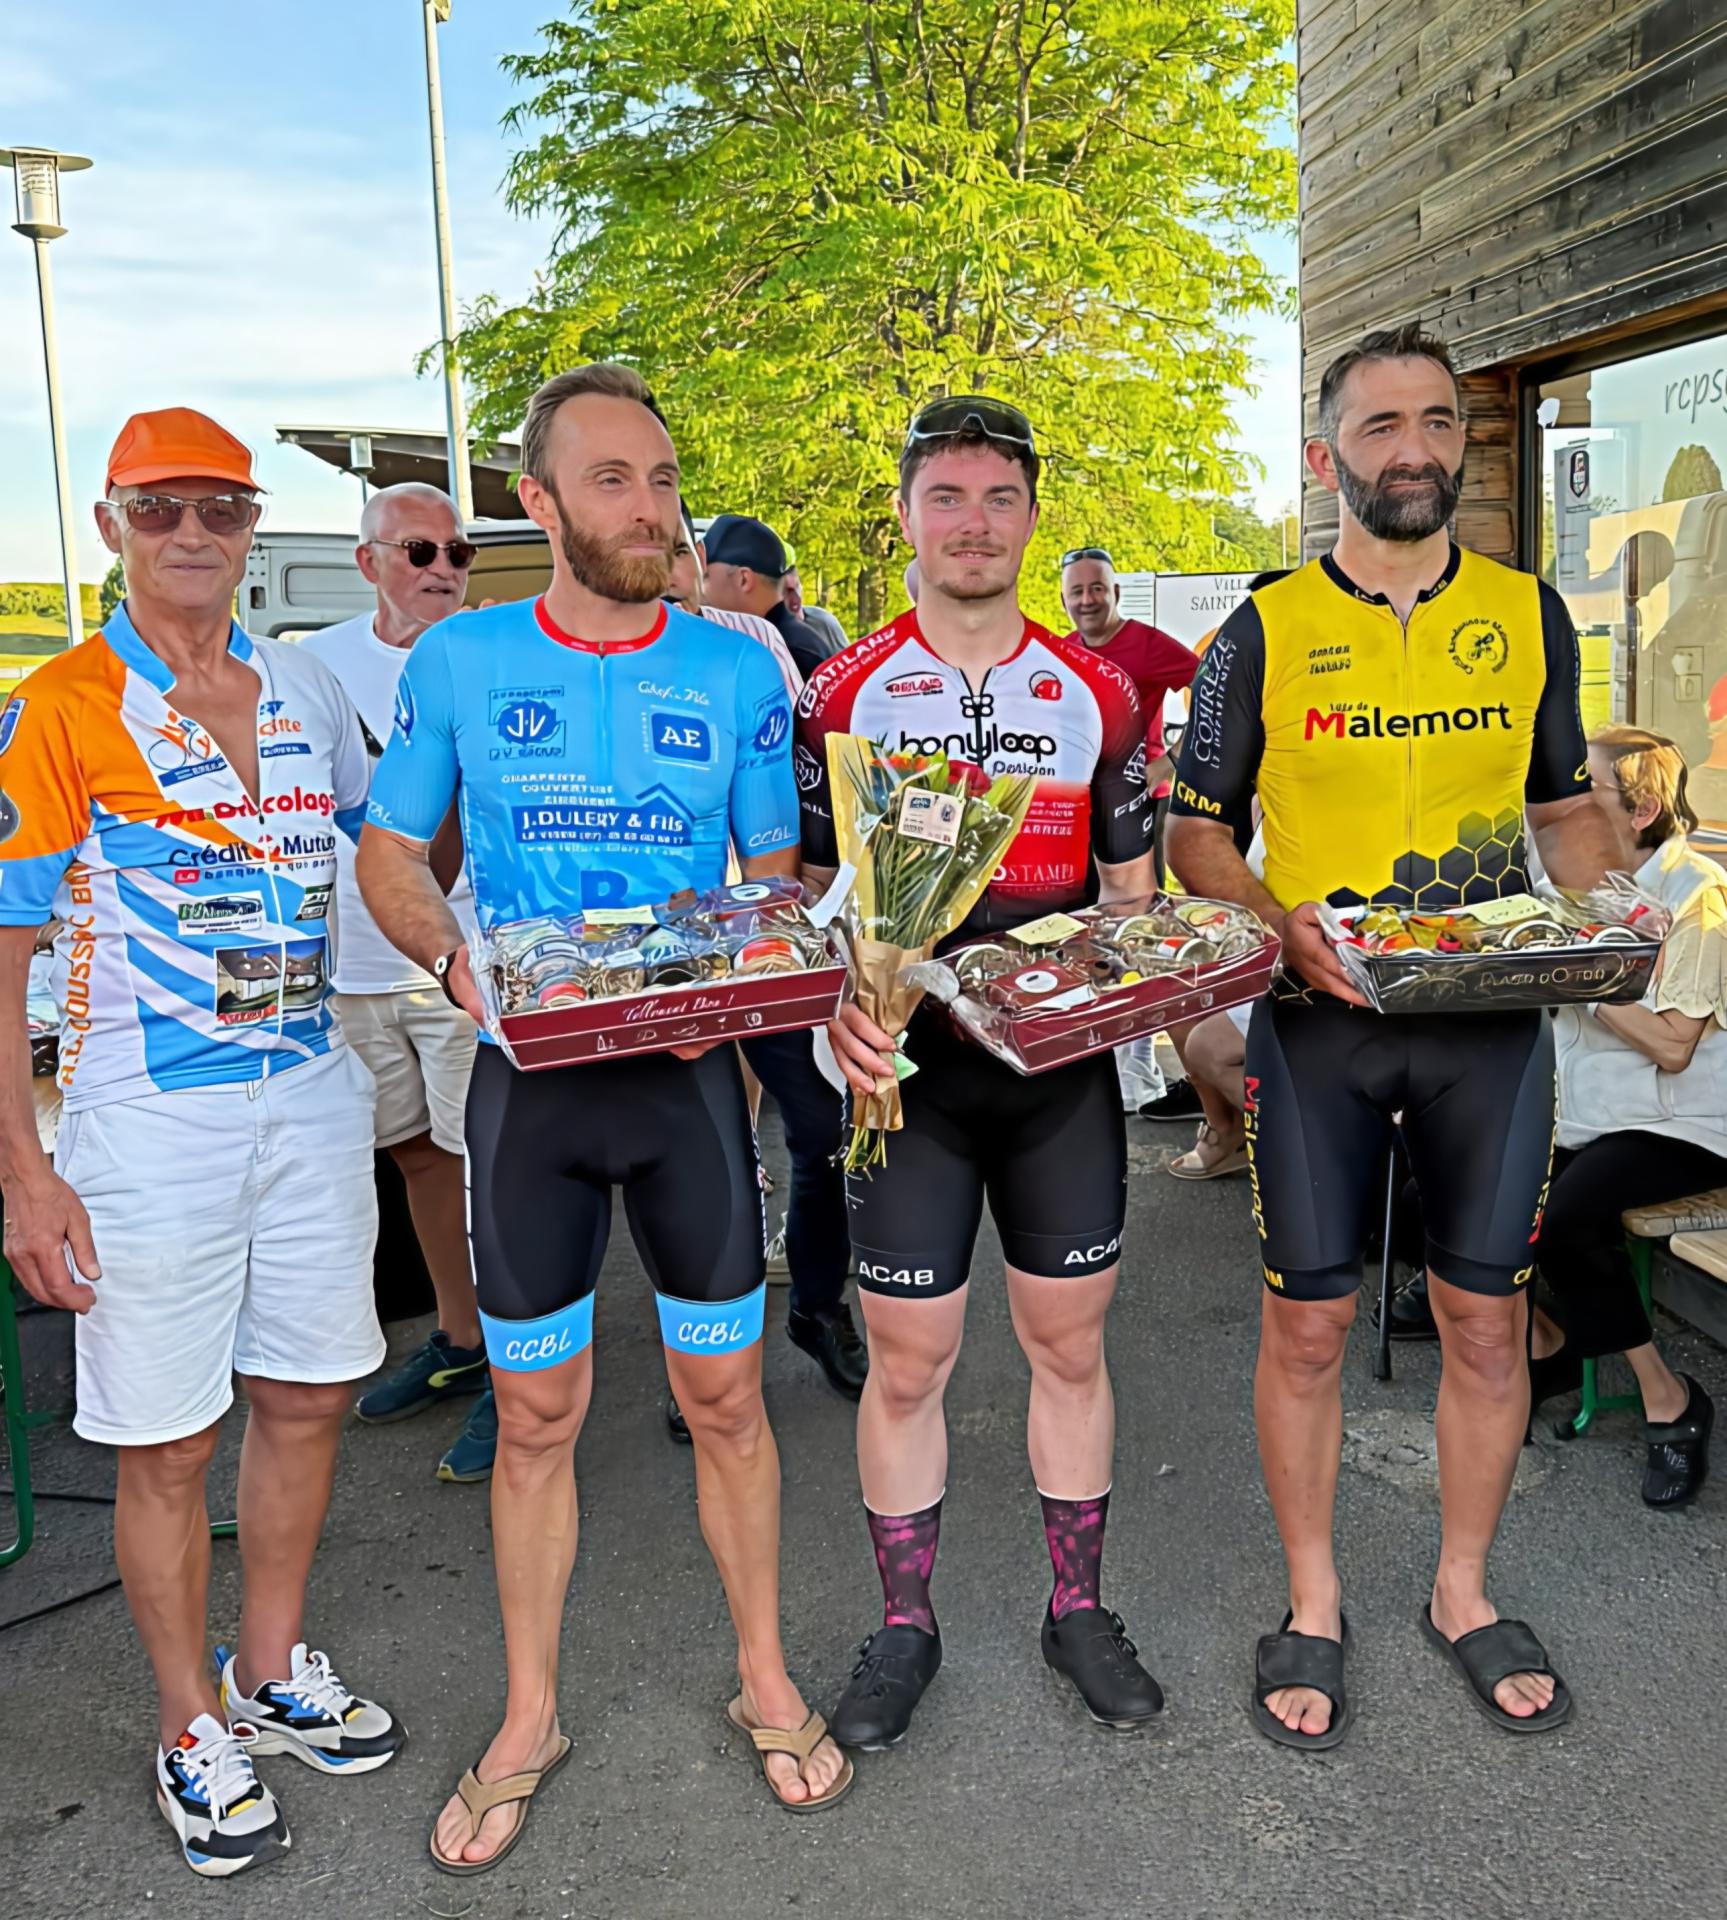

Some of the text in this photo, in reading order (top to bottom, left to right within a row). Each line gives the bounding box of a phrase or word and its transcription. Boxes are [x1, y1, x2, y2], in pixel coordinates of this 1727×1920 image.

[1665, 368, 1727, 424] rcps
[1190, 595, 1237, 611] SAINT
[1304, 702, 1513, 741] Malemort
[660, 725, 702, 749] AE
[1176, 781, 1222, 815] CRM
[627, 813, 643, 828] &
[1064, 1231, 1124, 1265] AC4
[859, 1261, 934, 1286] AC4B
[505, 1327, 572, 1362] CCBL
[678, 1318, 745, 1345] CCBL
